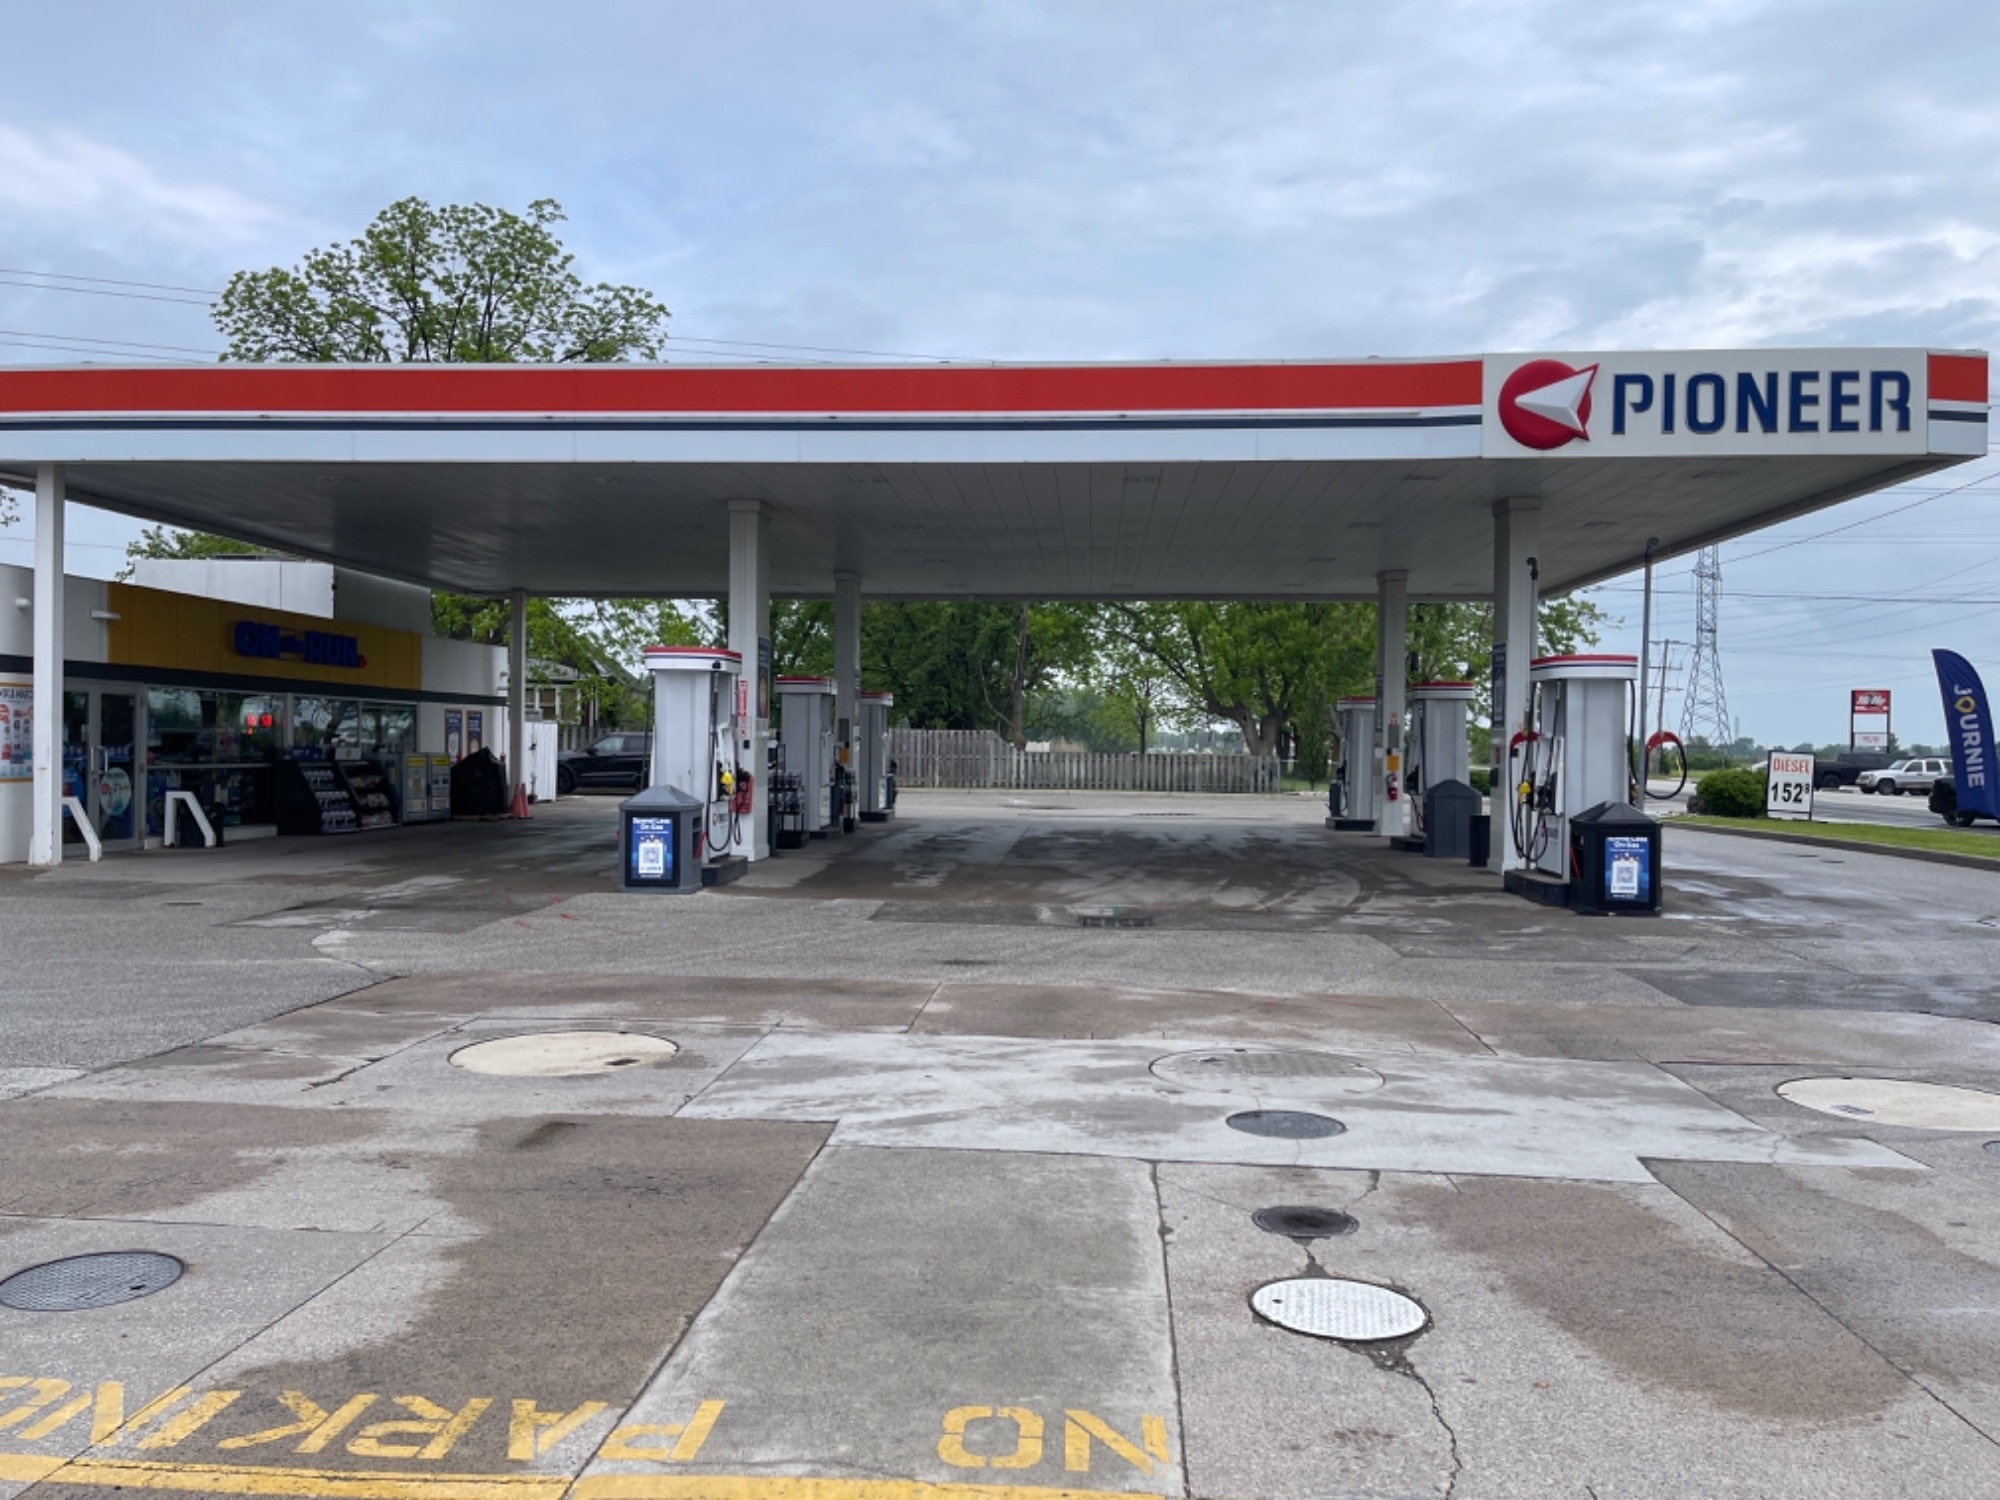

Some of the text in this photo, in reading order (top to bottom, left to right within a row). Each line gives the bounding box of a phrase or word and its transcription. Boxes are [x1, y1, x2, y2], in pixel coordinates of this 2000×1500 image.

[1612, 369, 1911, 434] PIONEER
[234, 621, 280, 659] ON
[304, 631, 358, 668] RUN
[1773, 757, 1810, 774] DIESEL
[1954, 684, 1985, 788] JOURNIE
[936, 1403, 1170, 1472] NO
